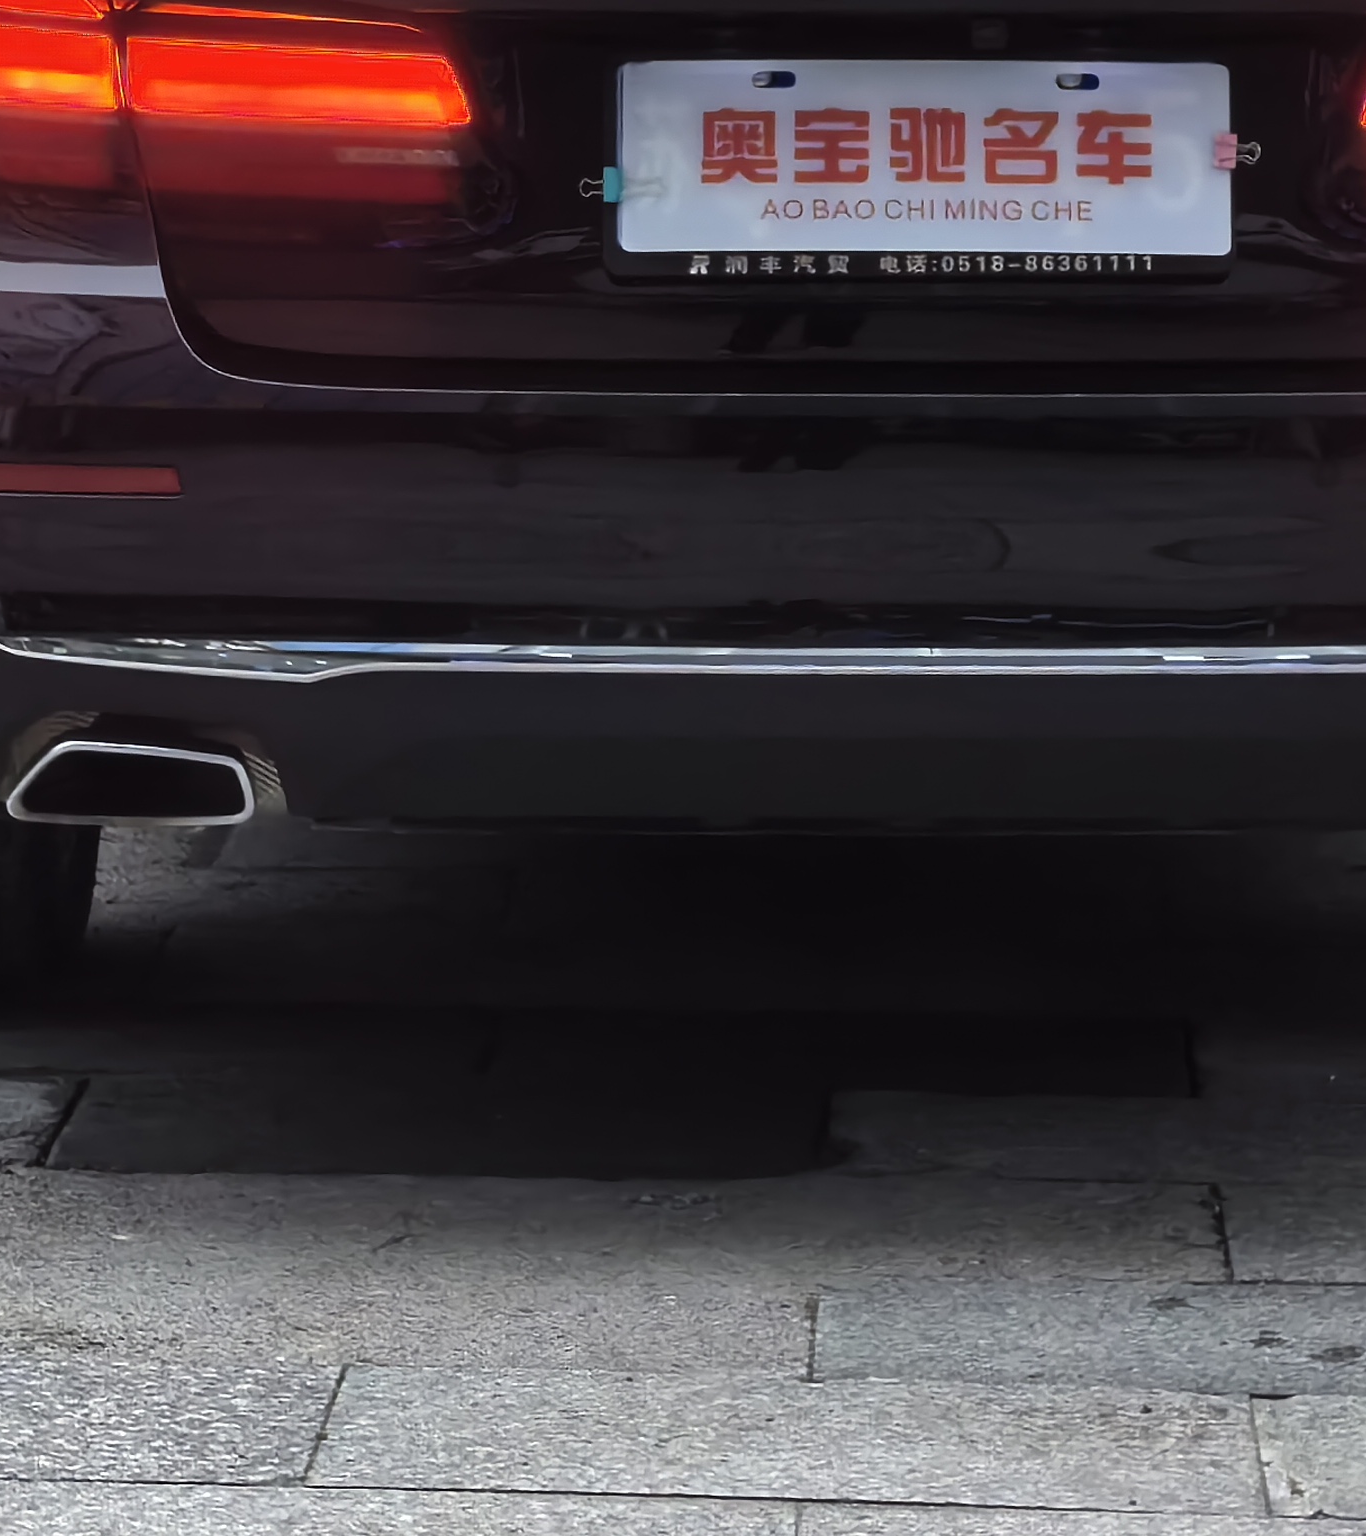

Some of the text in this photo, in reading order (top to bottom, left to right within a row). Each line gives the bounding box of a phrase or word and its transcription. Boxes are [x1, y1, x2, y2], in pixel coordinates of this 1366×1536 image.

[700, 107, 1153, 185] 奥宝驰名车
[760, 199, 1093, 222] AO BAO CHI MING CHE
